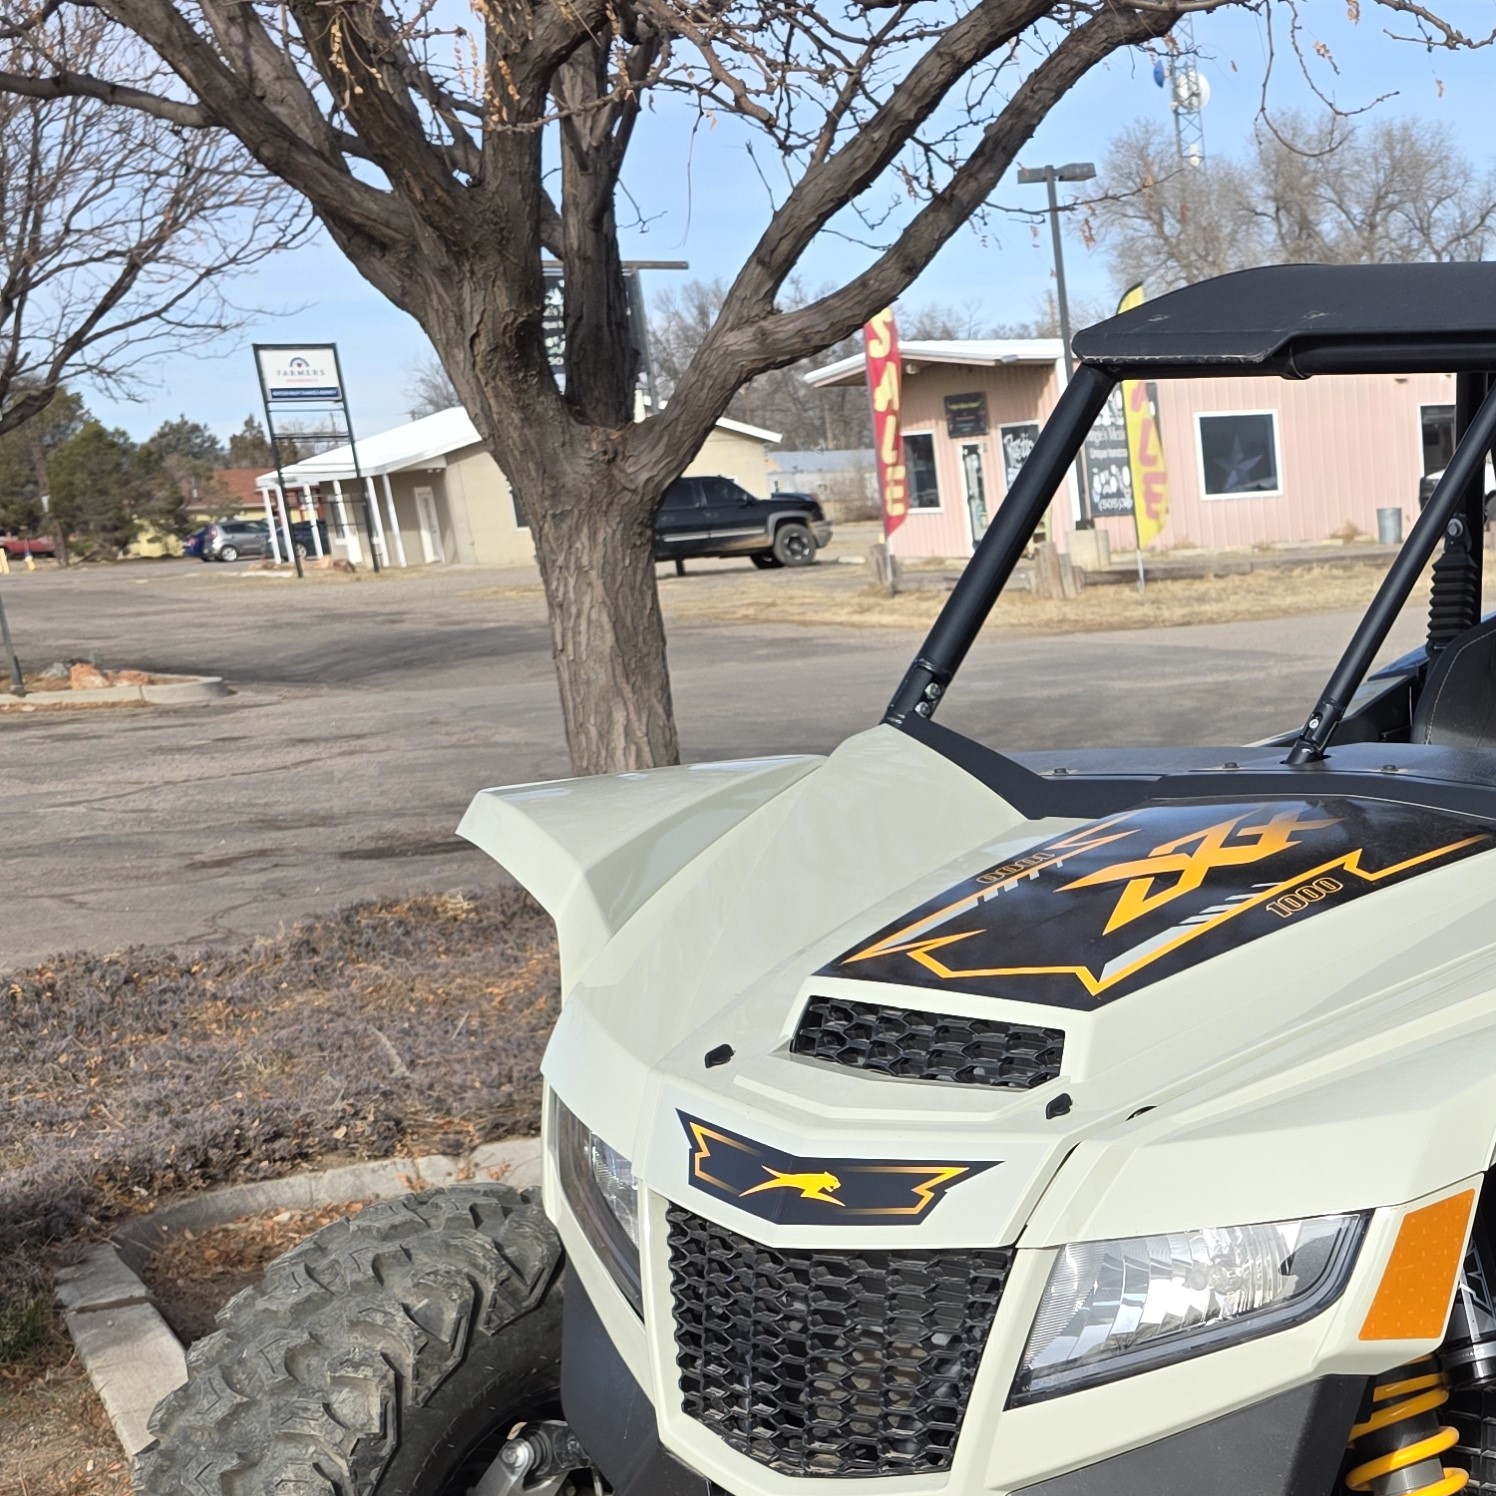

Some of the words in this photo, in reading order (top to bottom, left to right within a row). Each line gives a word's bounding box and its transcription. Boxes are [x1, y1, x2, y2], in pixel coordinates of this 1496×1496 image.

[276, 368, 326, 377] FARMERS
[867, 307, 907, 517] SALE
[1131, 381, 1169, 521] LE
[1265, 877, 1344, 919] 1000
